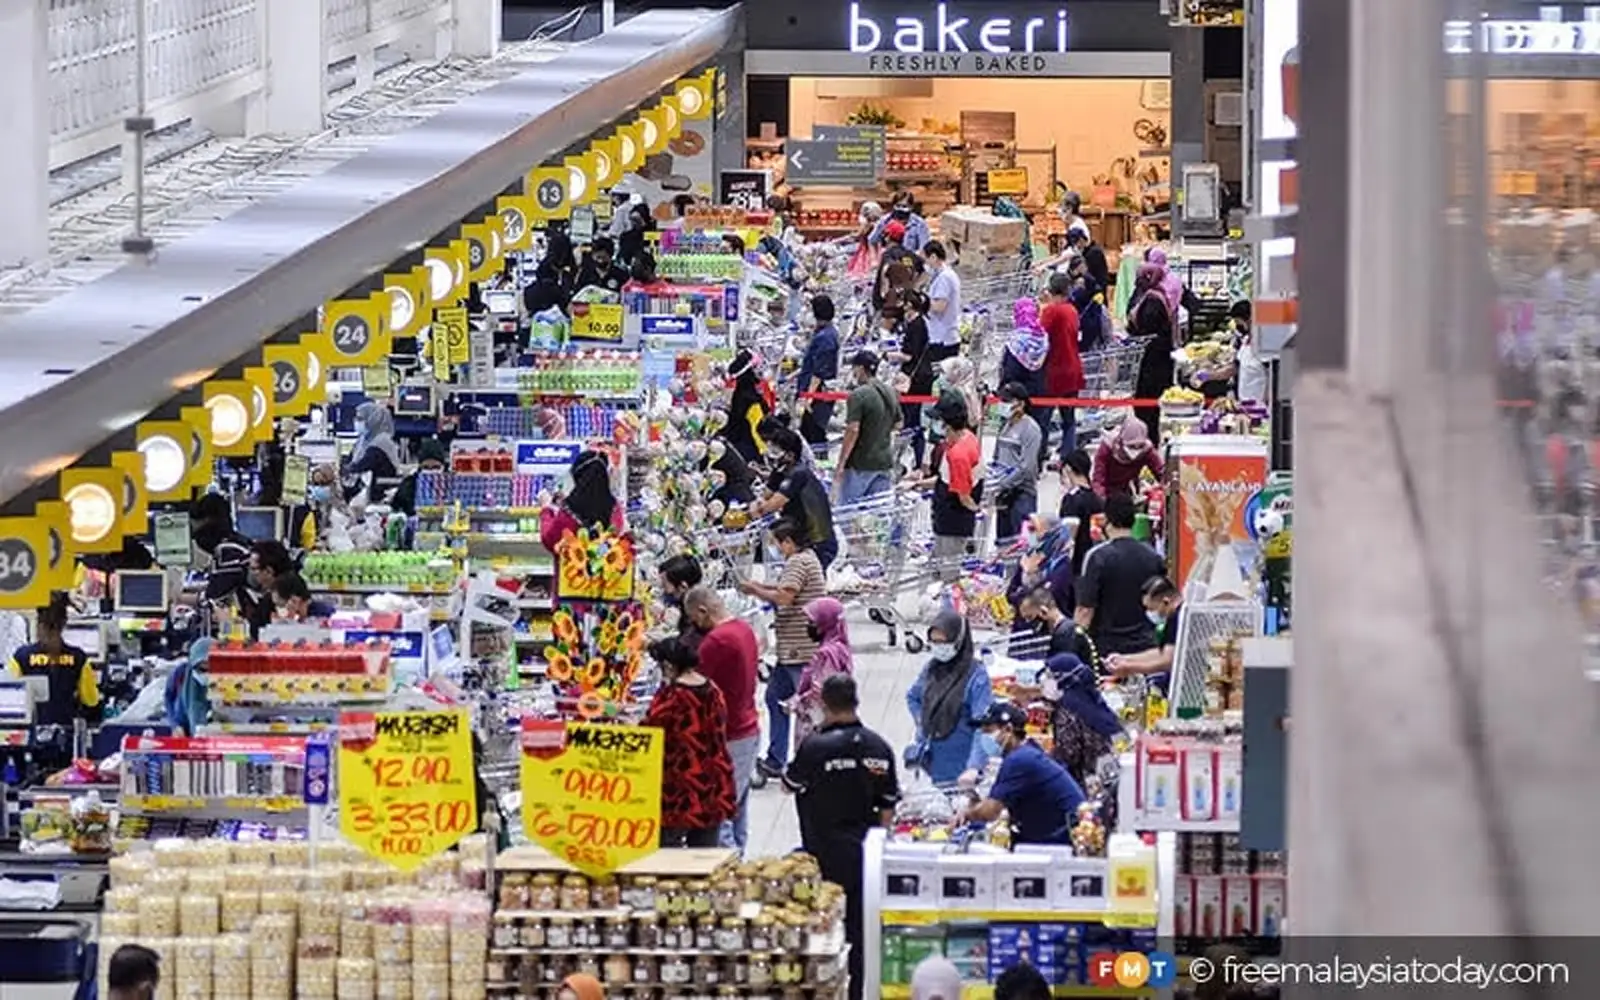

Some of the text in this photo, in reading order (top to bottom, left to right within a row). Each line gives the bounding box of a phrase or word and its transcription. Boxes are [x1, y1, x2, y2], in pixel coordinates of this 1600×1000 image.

[849, 1, 1068, 53] bakeri
[868, 55, 1047, 72] FRESHLY BAKED
[540, 186, 561, 202] 13
[336, 326, 367, 346] 24
[374, 755, 451, 788] 12.90
[350, 800, 472, 836] 3 33.00
[532, 808, 656, 849] 6 50.00
